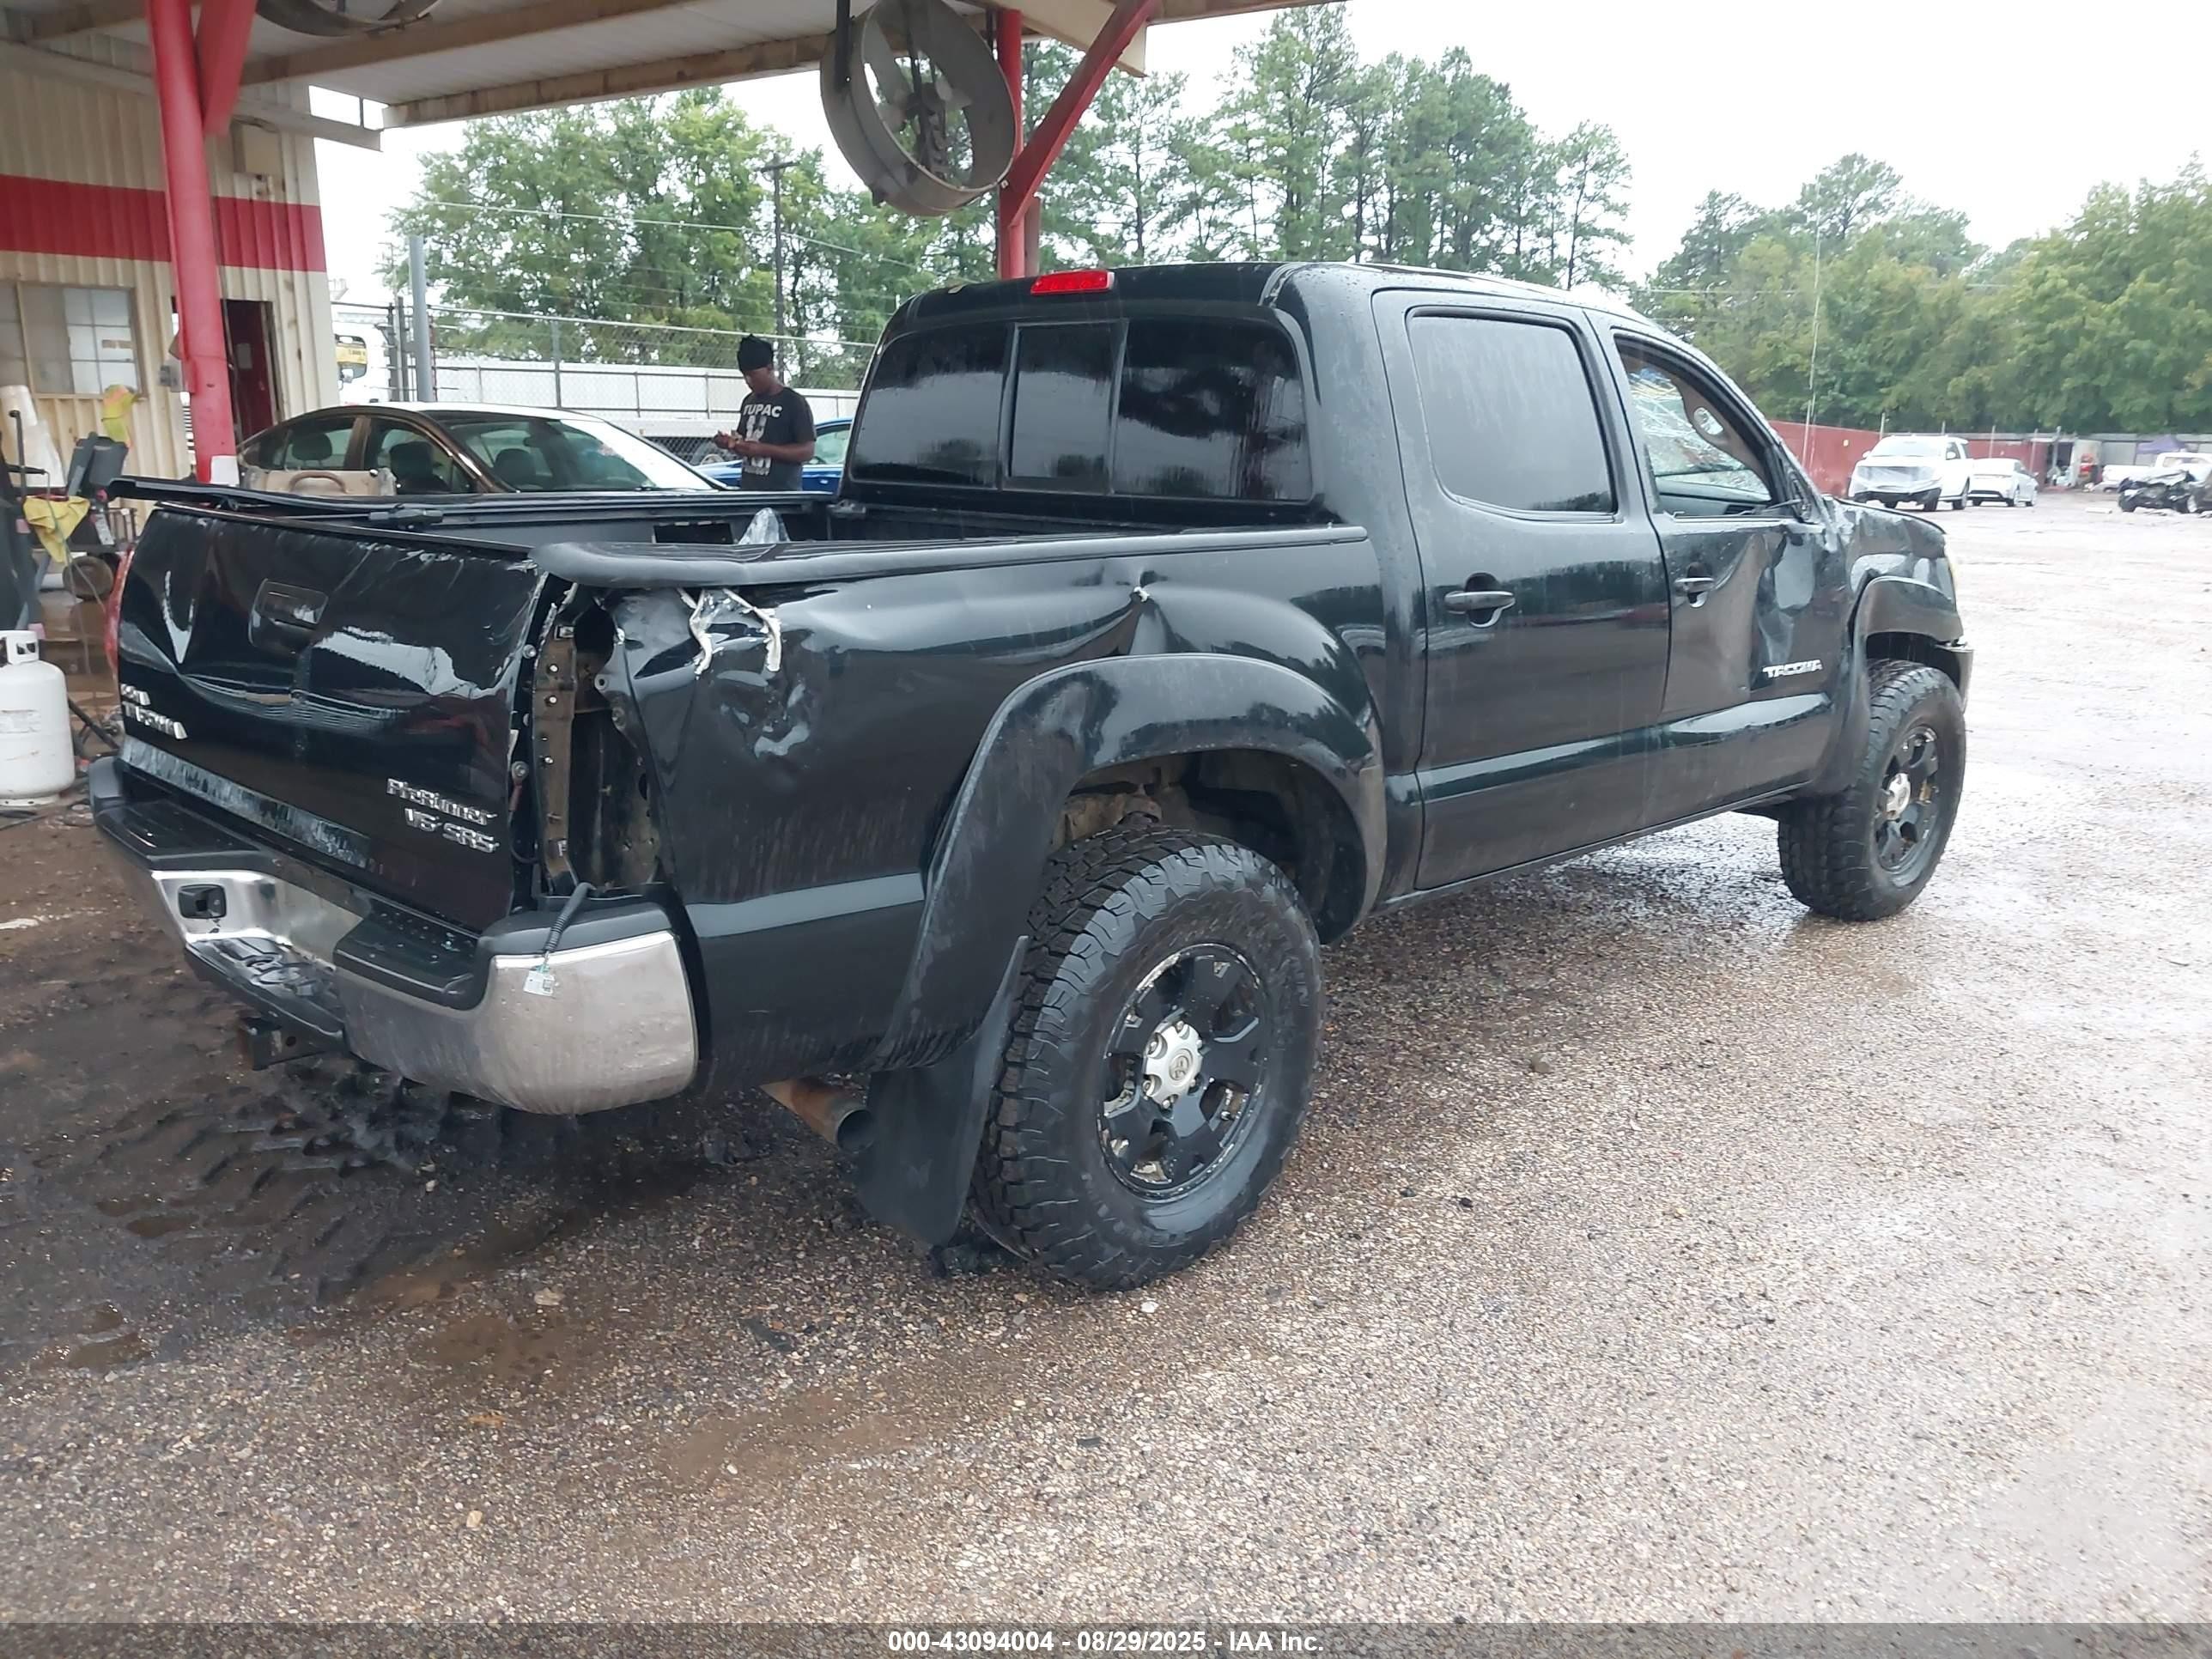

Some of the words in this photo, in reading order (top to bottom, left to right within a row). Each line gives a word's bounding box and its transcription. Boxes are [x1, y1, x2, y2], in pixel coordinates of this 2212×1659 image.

[743, 404, 783, 418] TUPAC
[1762, 659, 1823, 678] TACOMA
[404, 808, 442, 832] V6
[442, 823, 500, 854] SR5
